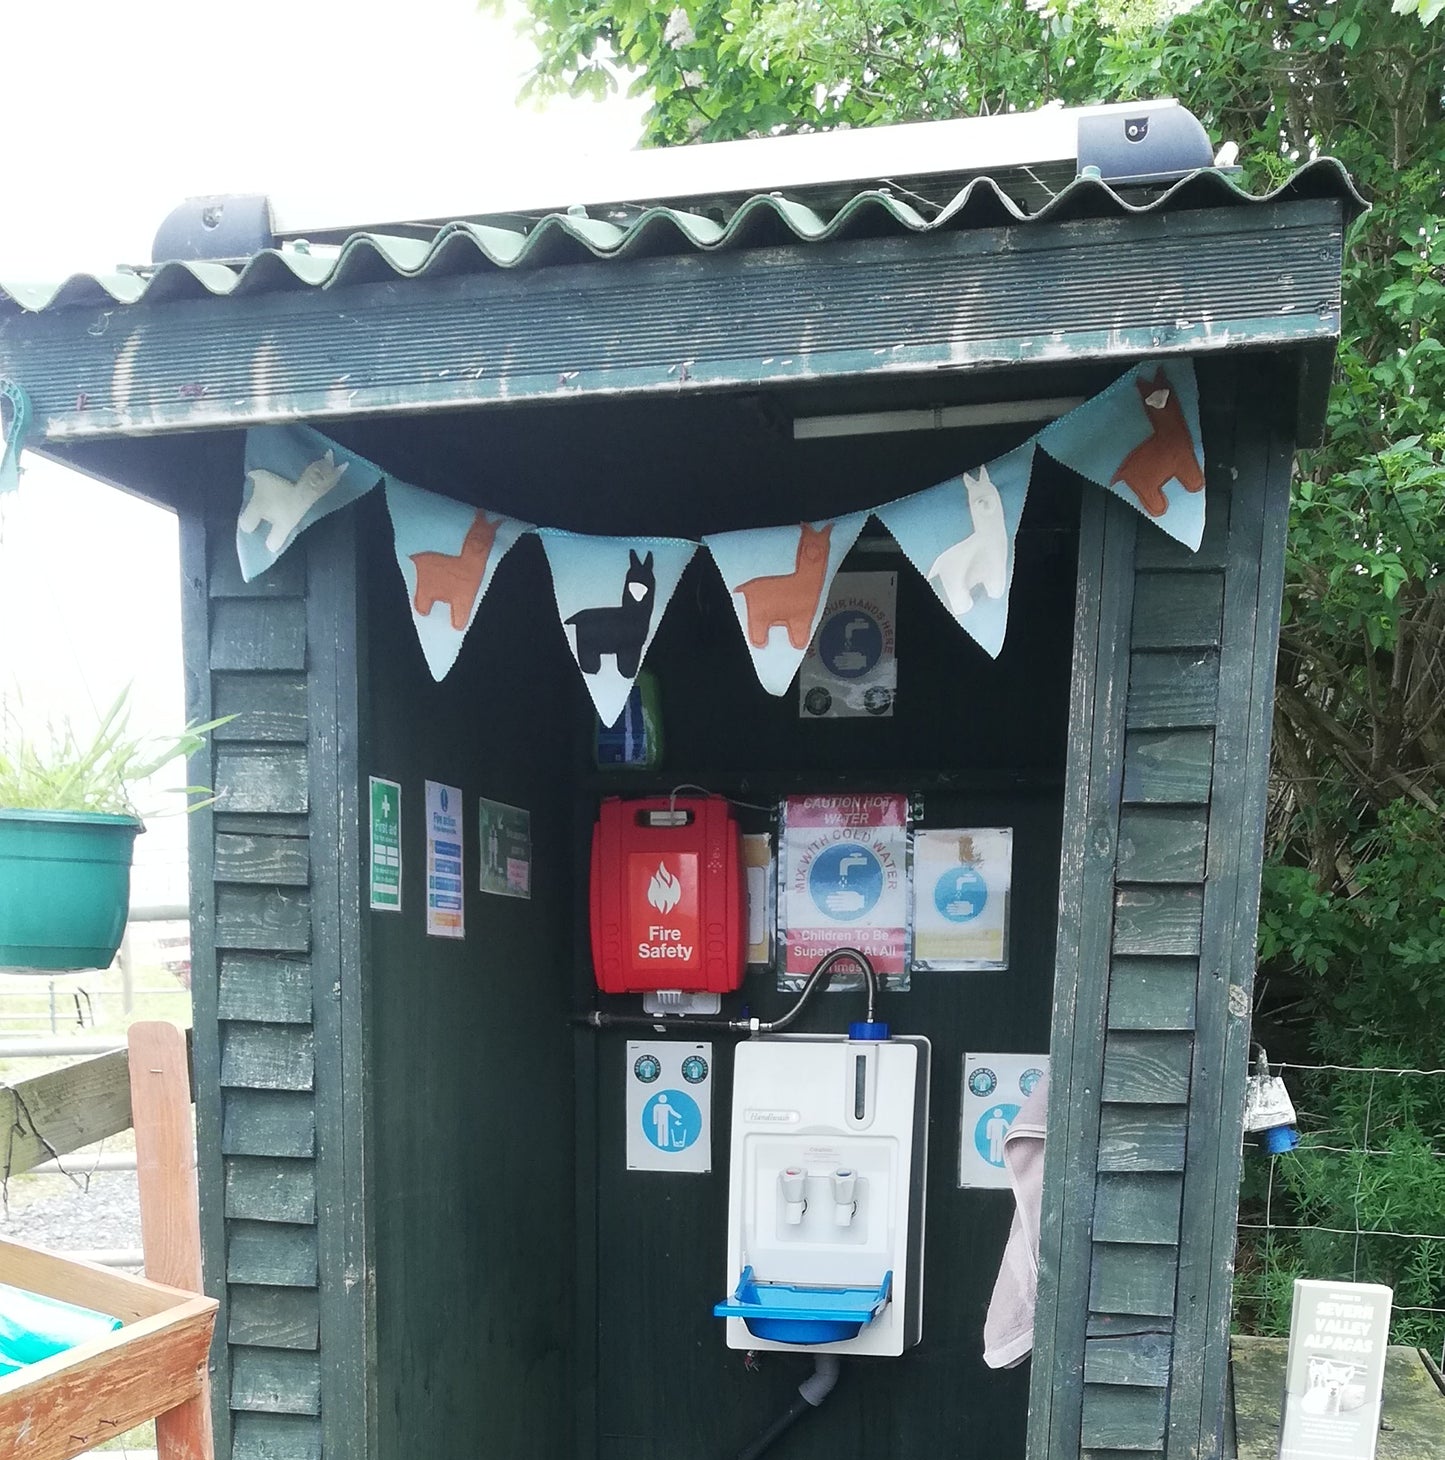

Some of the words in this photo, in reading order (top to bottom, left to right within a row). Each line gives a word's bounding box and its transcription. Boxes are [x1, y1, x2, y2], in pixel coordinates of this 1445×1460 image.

[823, 599, 848, 616] OUR
[849, 598, 884, 621] HANDS
[881, 620, 894, 655] HERE
[803, 796, 861, 809] CAUTION
[864, 796, 892, 808] HOT
[824, 813, 869, 825] WATER
[794, 868, 806, 893] MIX
[800, 834, 829, 865] WITH
[832, 828, 871, 843] COLD
[872, 840, 898, 890] WATER
[649, 926, 681, 941] Fire
[802, 929, 852, 941] Children
[855, 930, 869, 941] To
[873, 930, 889, 940] Be
[638, 943, 693, 961] Safety
[794, 945, 861, 958] Super
[863, 946, 877, 956] At
[879, 946, 896, 956] All
[1316, 1302, 1375, 1321] SEVERN
[1315, 1318, 1372, 1337] VALLEY
[1303, 1333, 1374, 1353] ALPACAS
